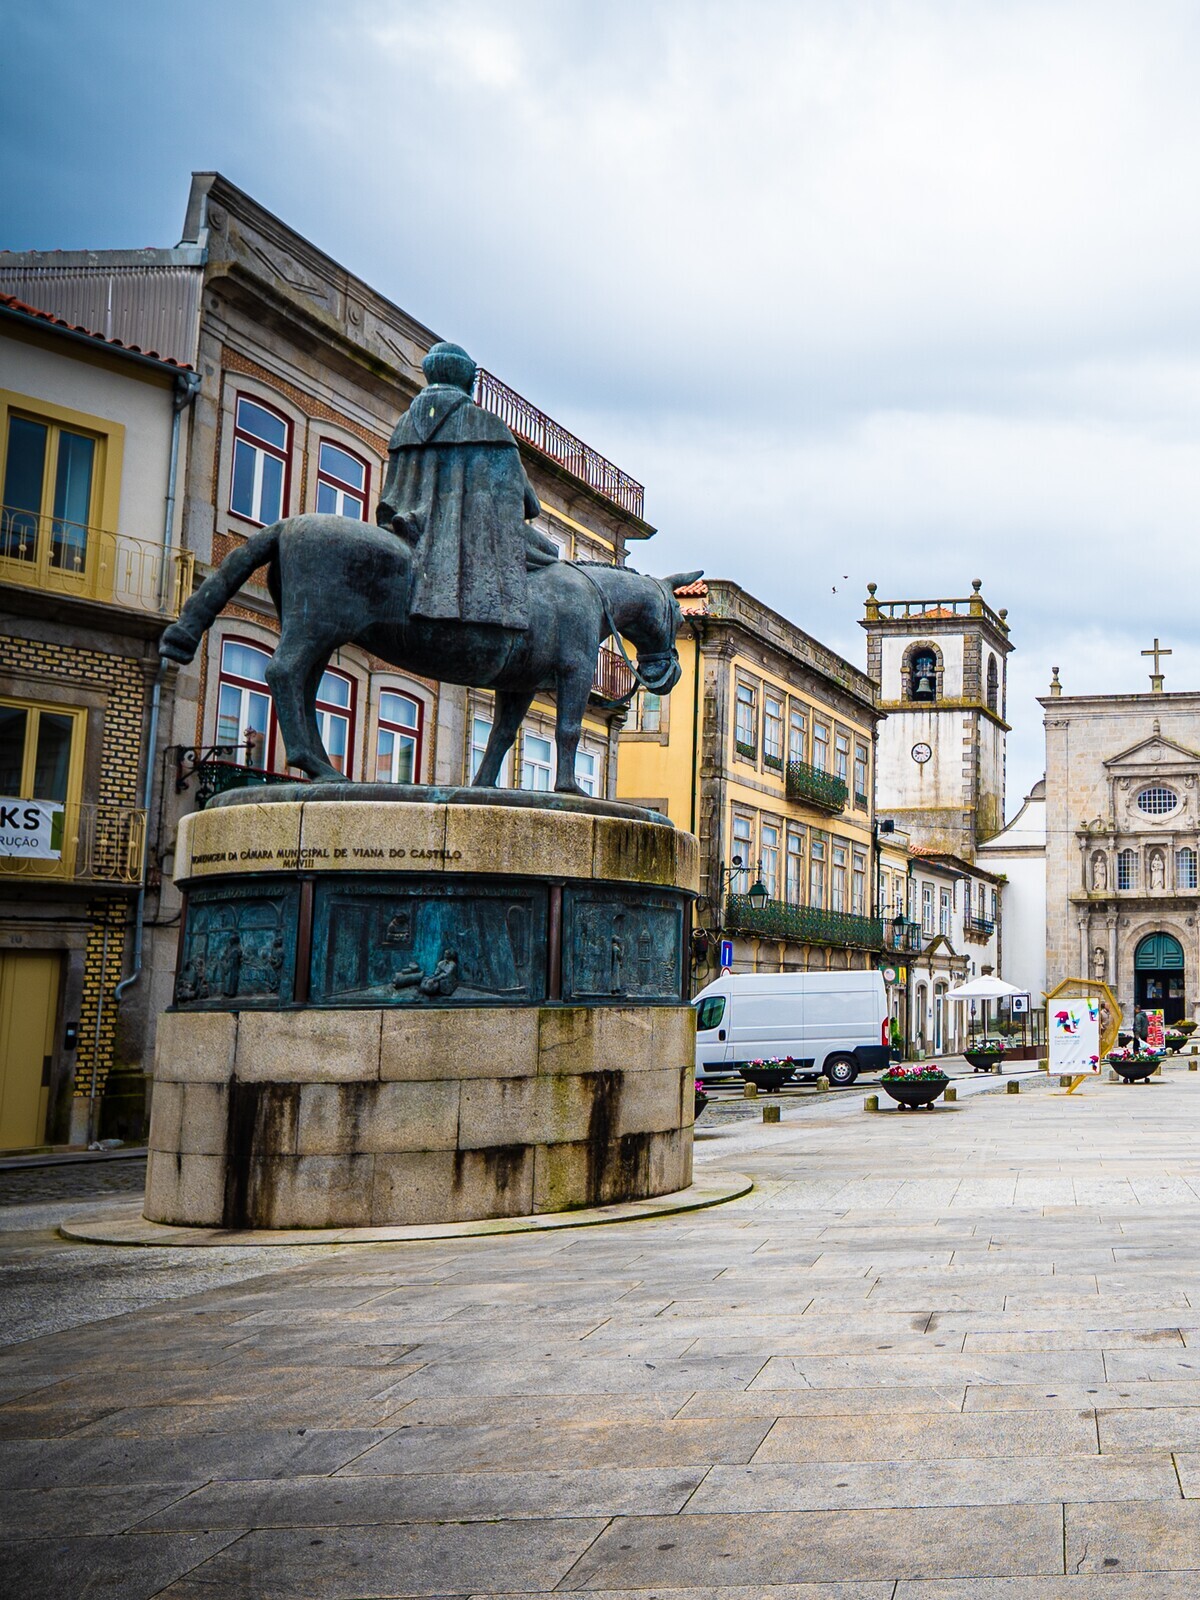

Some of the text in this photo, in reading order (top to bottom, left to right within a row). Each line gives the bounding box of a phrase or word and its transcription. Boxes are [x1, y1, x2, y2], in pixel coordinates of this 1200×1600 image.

[228, 852, 238, 860] DA
[240, 848, 273, 860] CÂMARA
[276, 847, 330, 859] MUNICIPAL
[333, 848, 348, 858] DE
[352, 848, 384, 858] VIANA
[389, 848, 406, 858] DO
[410, 849, 462, 859] CASTELO
